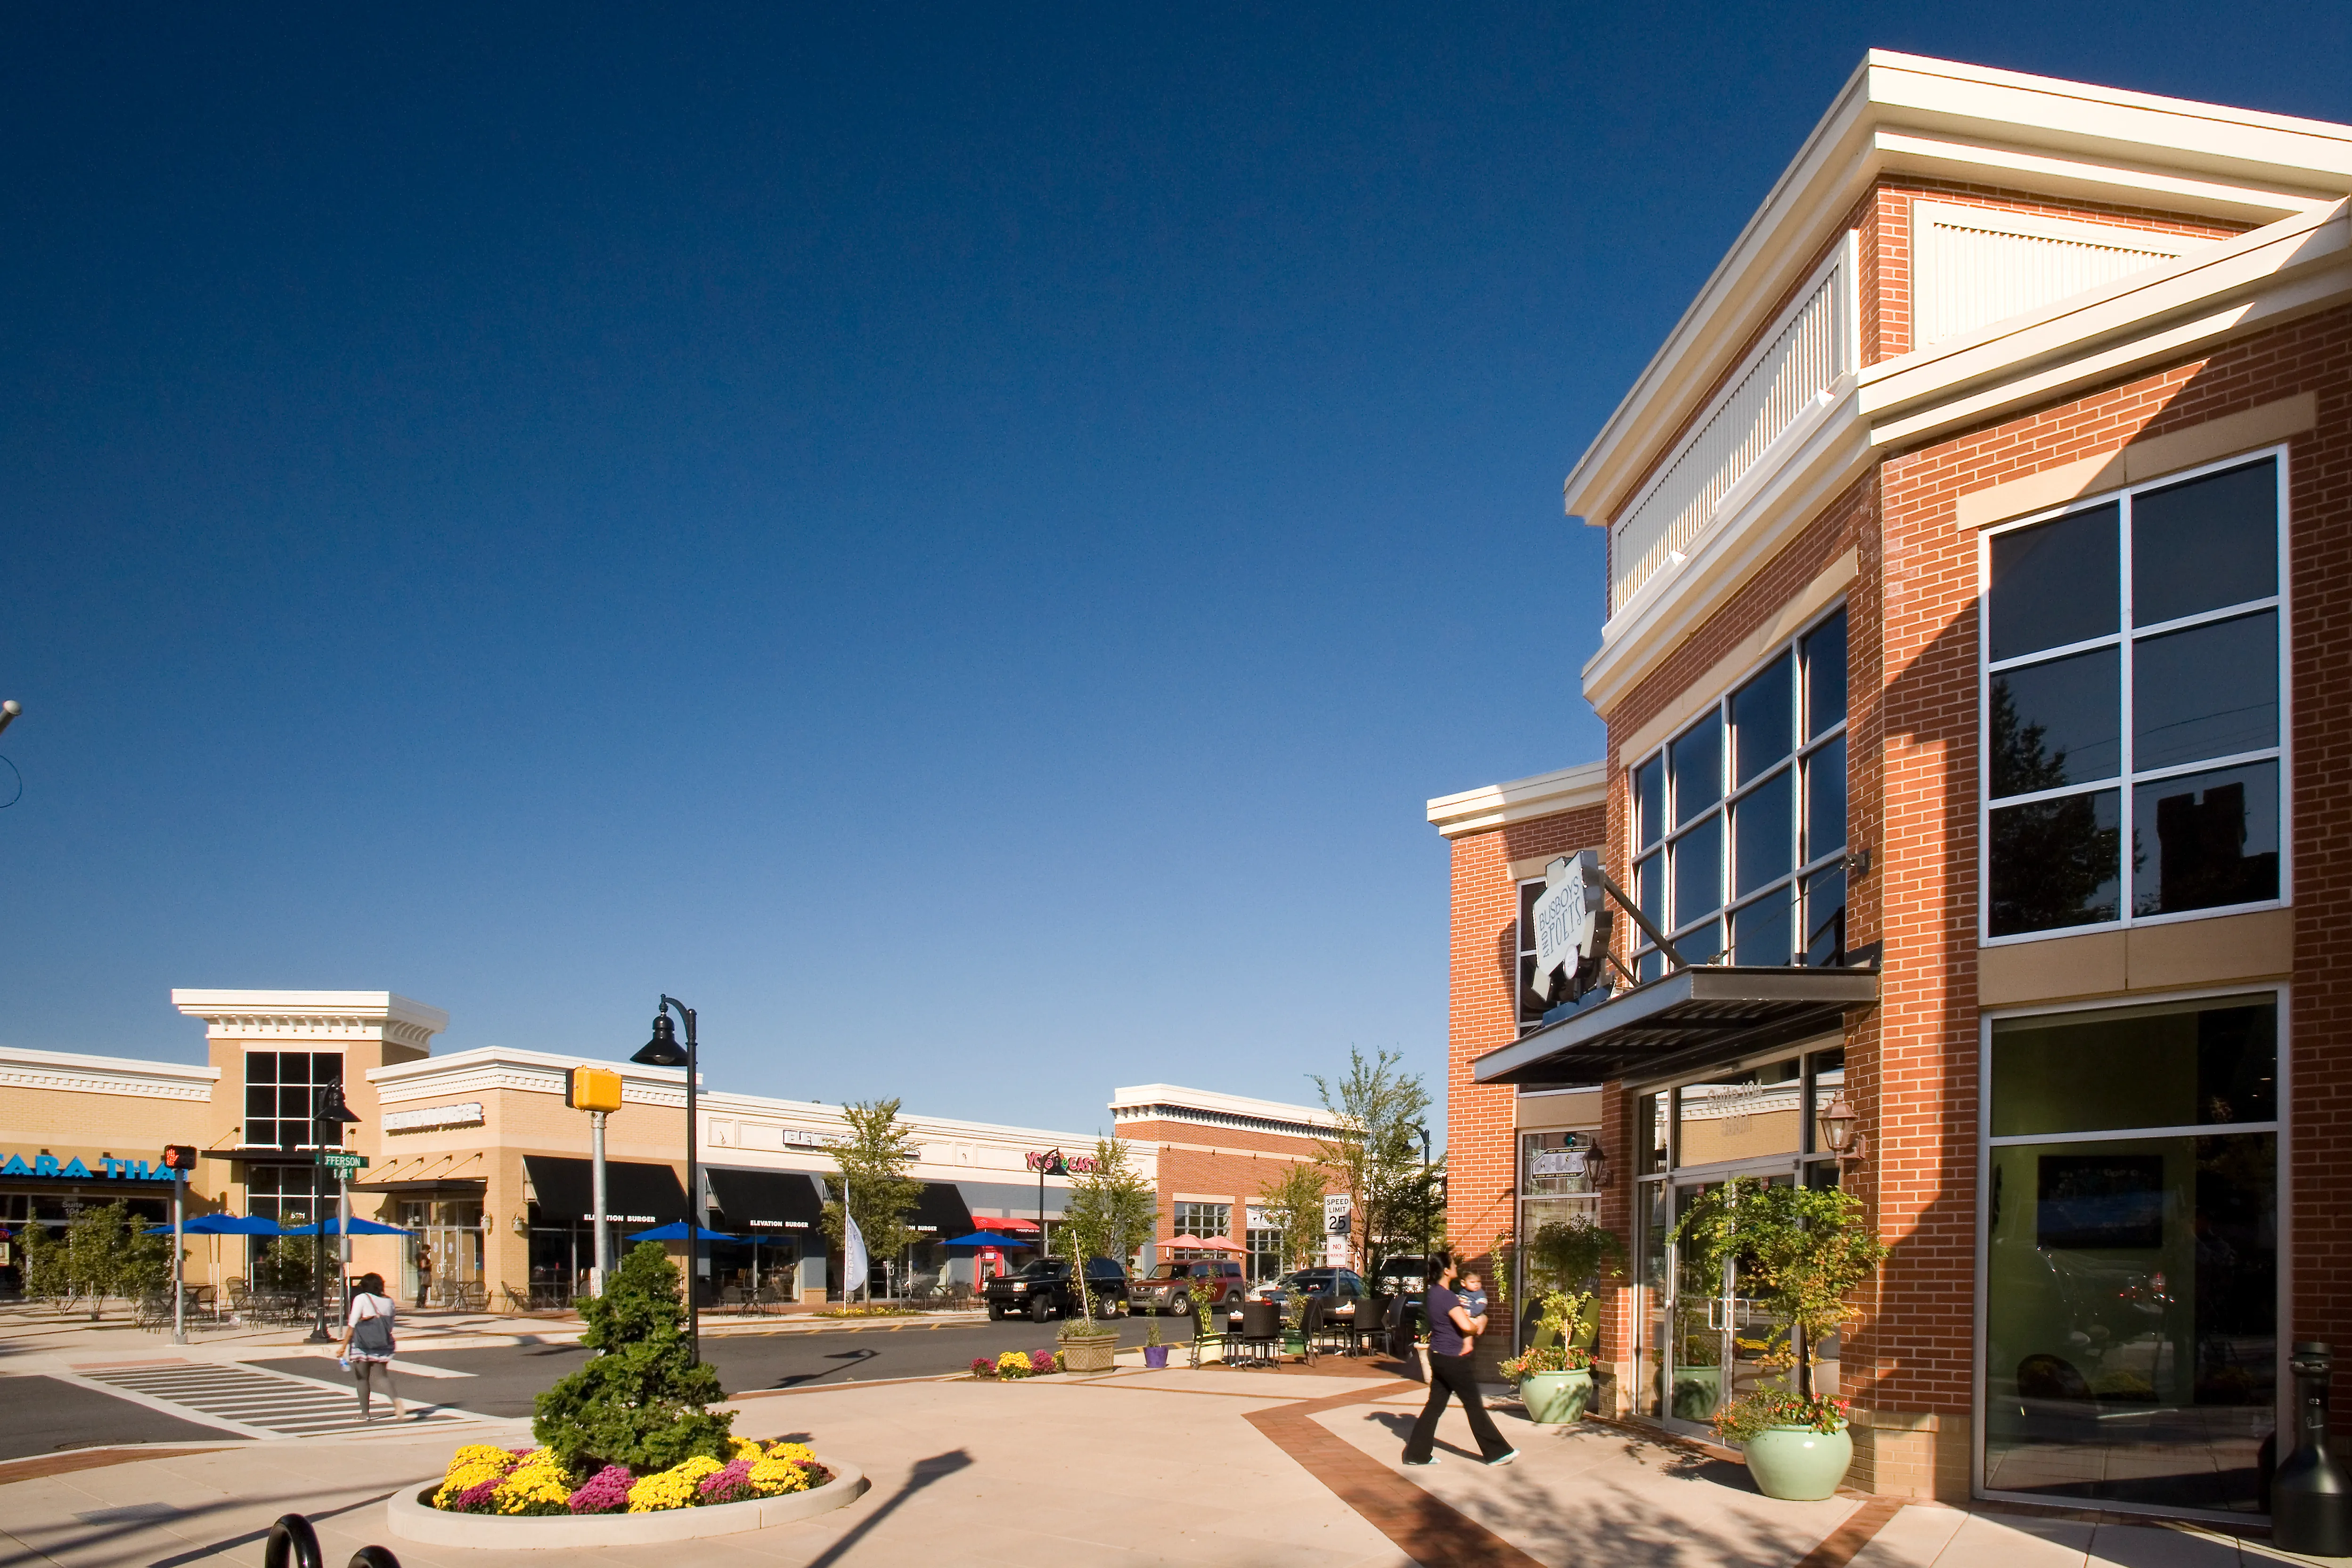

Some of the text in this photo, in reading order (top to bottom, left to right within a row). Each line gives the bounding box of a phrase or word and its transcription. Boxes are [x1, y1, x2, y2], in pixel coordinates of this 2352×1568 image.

[1539, 876, 1579, 931] BUSBOYS
[1548, 897, 1582, 954] POETS
[1541, 931, 1550, 958] AND
[1707, 1078, 1763, 1110] Suite 104
[0, 1153, 94, 1177] ARA
[315, 1156, 360, 1166] EFFERSON
[1026, 1152, 1099, 1172] YOG CAST
[1329, 1216, 1346, 1230] 25
